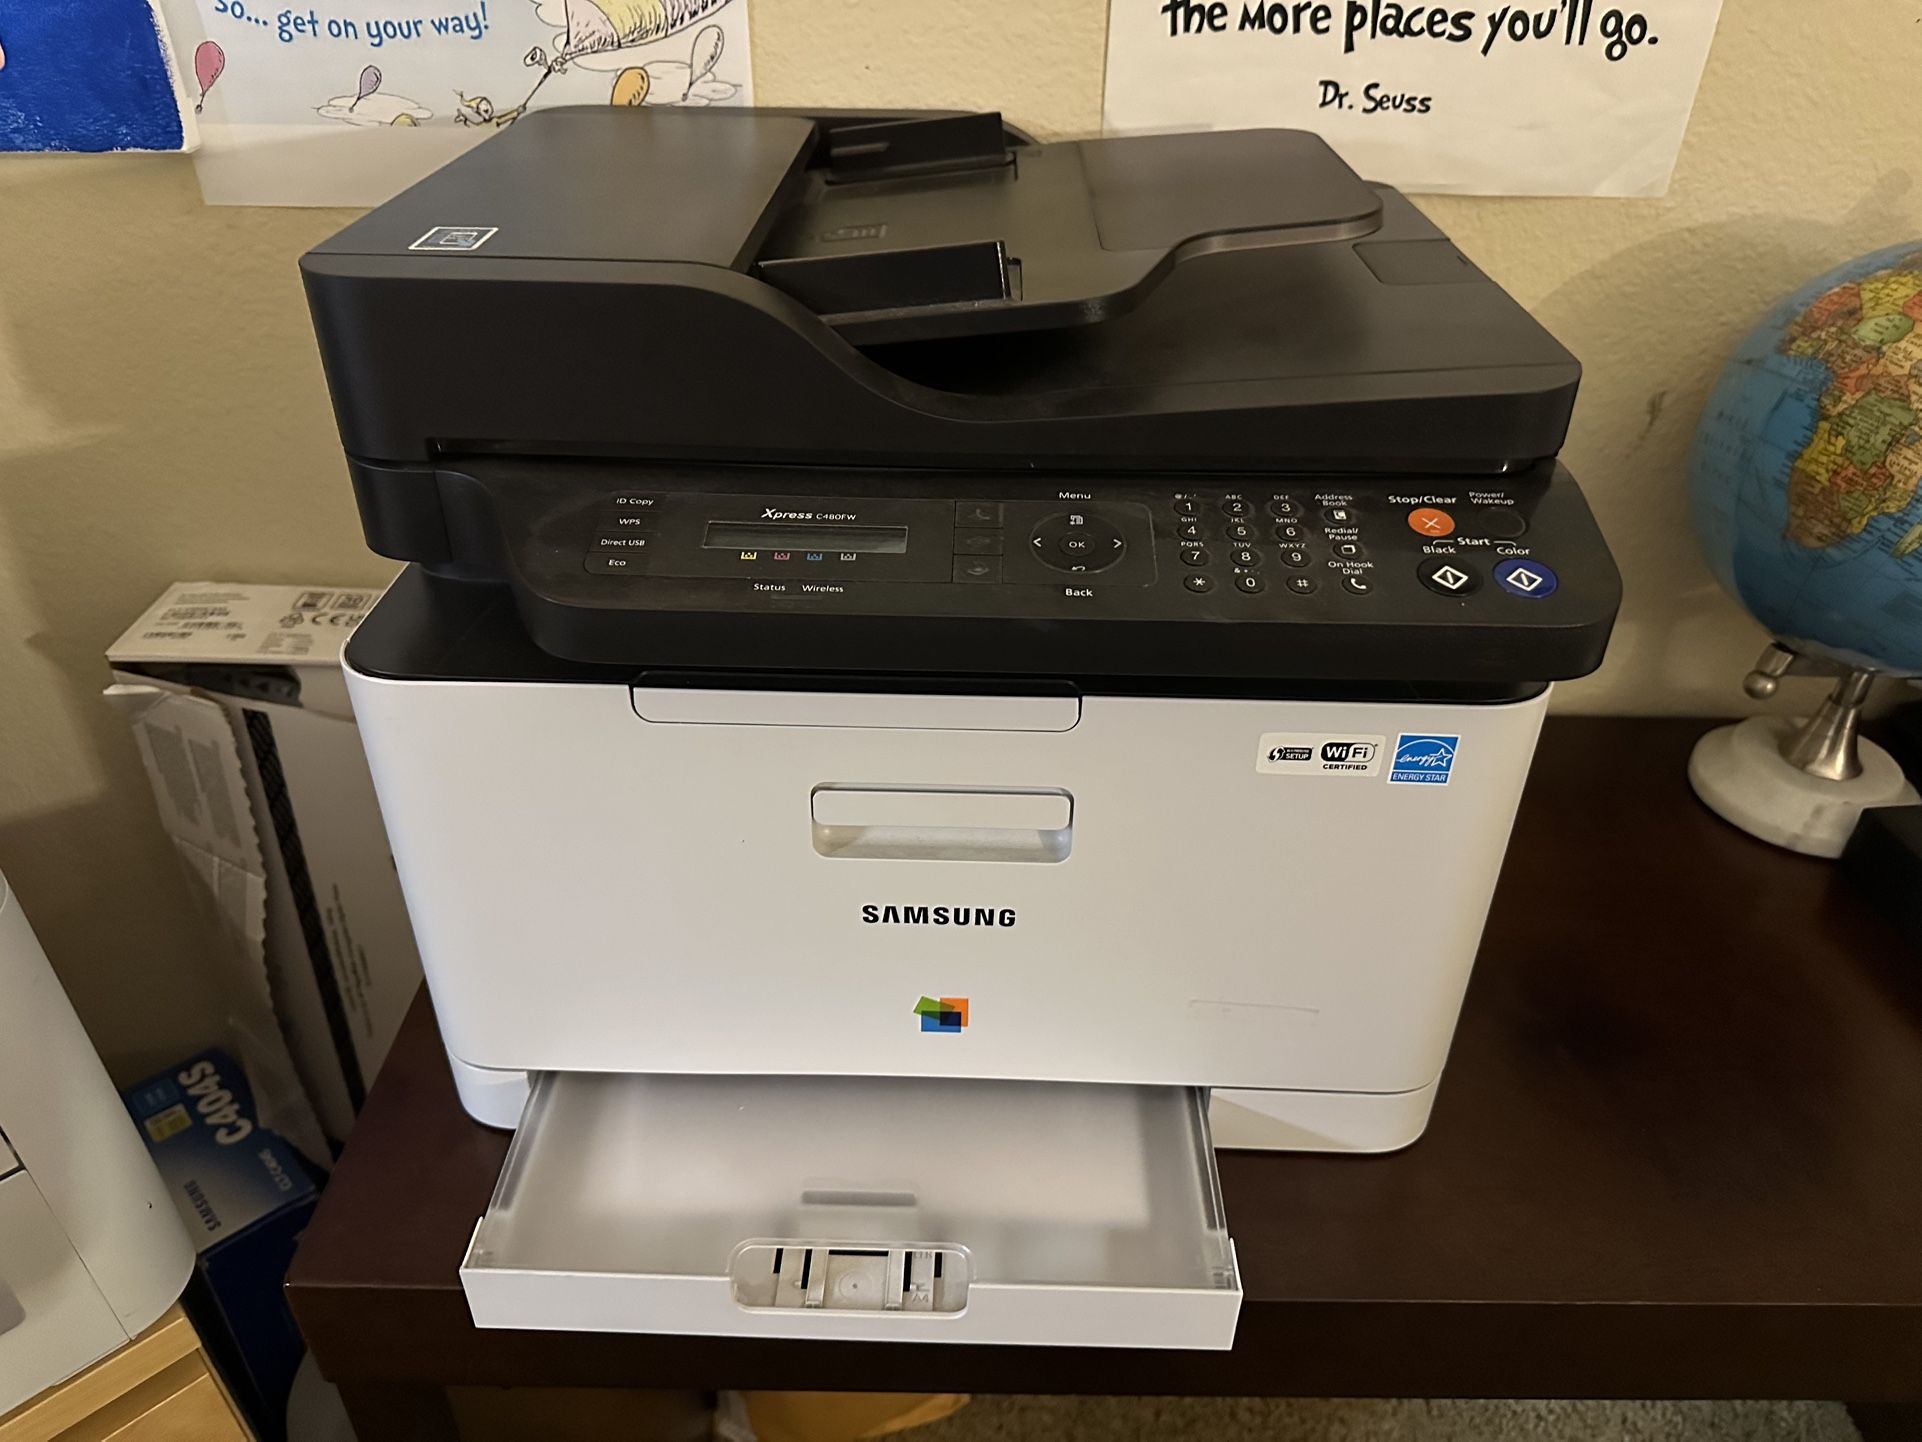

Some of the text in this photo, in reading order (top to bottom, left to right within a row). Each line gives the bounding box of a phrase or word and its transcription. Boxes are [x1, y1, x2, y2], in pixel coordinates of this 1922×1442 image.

[277, 10, 319, 42] get
[328, 19, 358, 40] on
[366, 20, 423, 47] your
[430, 1, 489, 40] way!
[1161, 0, 1228, 37] the
[1343, 0, 1476, 54] places
[1481, 0, 1593, 57] you'll
[1600, 9, 1659, 62] go.
[1318, 80, 1432, 114] Dr. Seuss
[629, 498, 654, 506] Copy
[1388, 495, 1457, 505] Stop/Clear
[1471, 497, 1515, 505] Wakeup
[1185, 502, 1192, 511] 1
[1232, 502, 1242, 512] 2
[1281, 502, 1291, 512] 3
[761, 508, 813, 520] Xpress
[1187, 526, 1196, 535] 4
[1237, 526, 1247, 536] 5
[1286, 527, 1296, 536] 6
[1457, 537, 1491, 546] Start
[1422, 545, 1456, 554] Black
[1496, 546, 1530, 555] Color
[1191, 551, 1200, 560] 7
[1241, 551, 1251, 561] 8
[1291, 552, 1302, 561] 9
[753, 583, 844, 593] Status Wireless
[1065, 588, 1093, 597] Back
[1393, 772, 1447, 782] ENERGY STAR
[862, 904, 1016, 927] SAMSUNG
[177, 1060, 254, 1146] C404S
[183, 1179, 222, 1232] SAMSUNG
